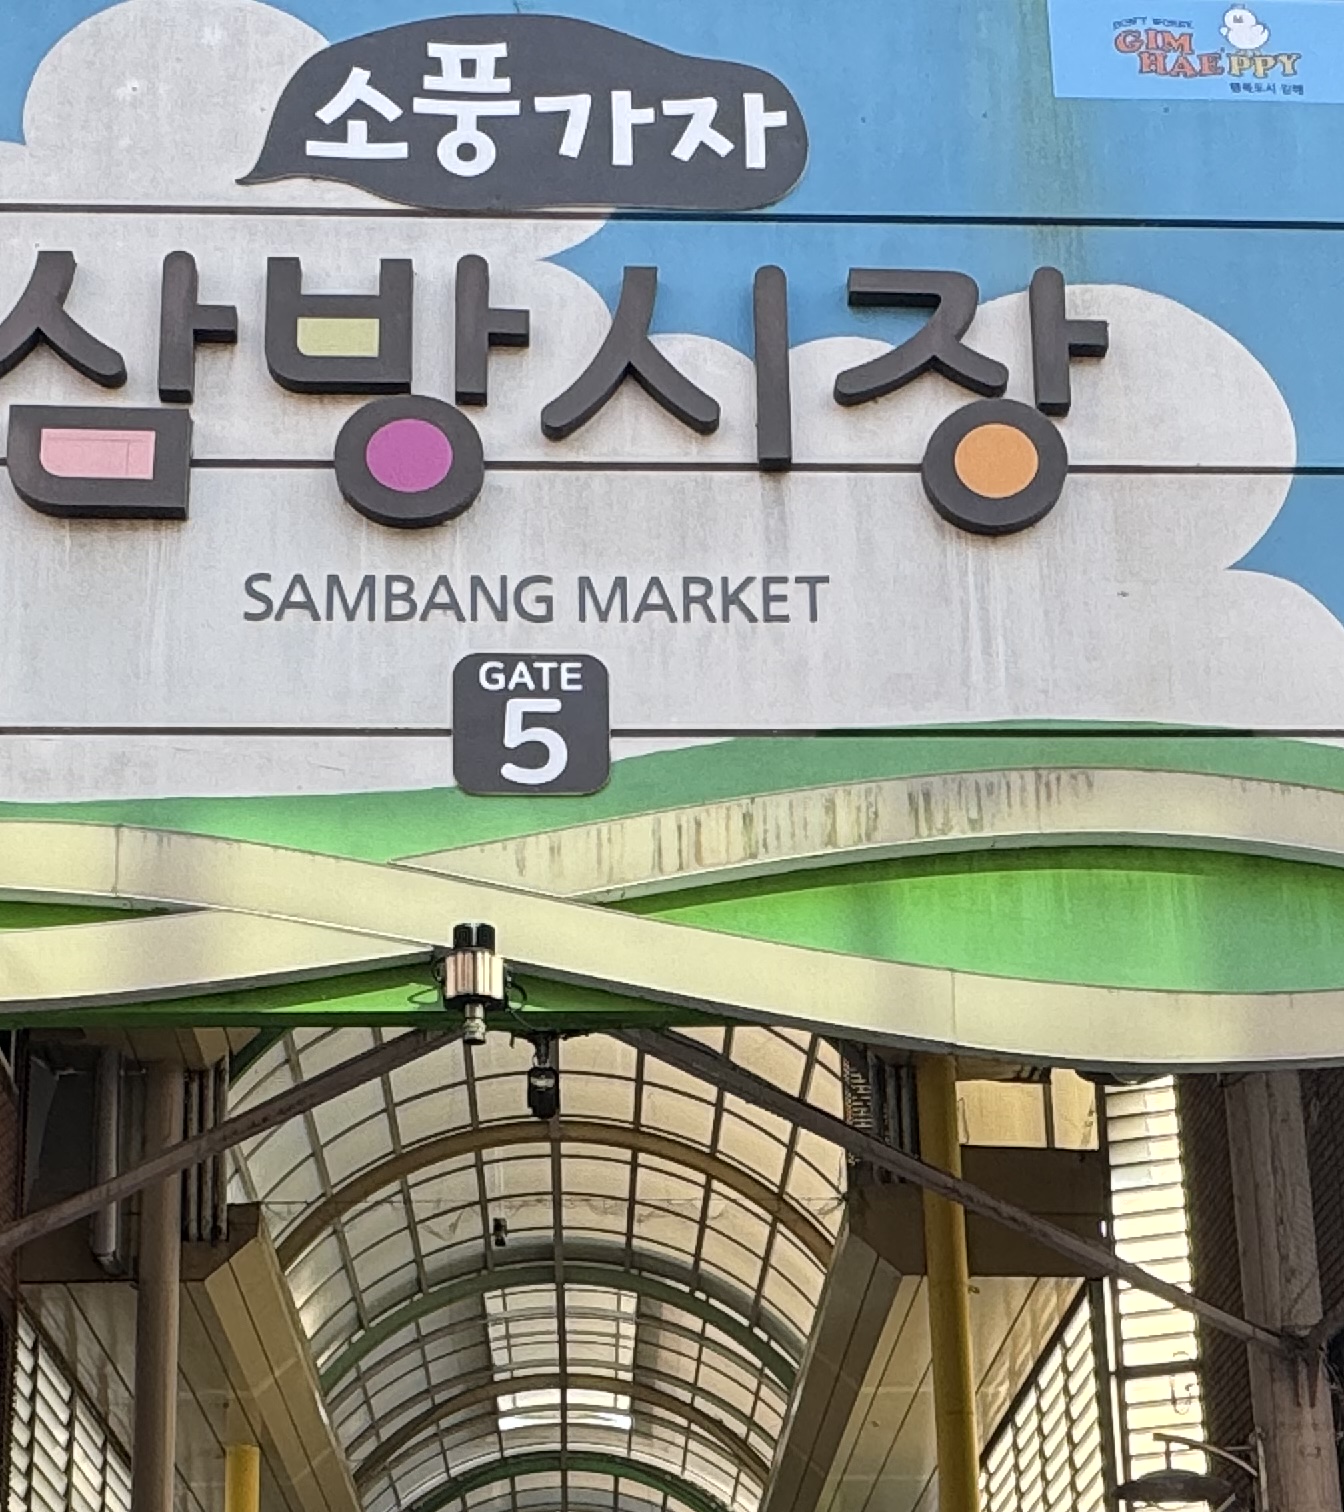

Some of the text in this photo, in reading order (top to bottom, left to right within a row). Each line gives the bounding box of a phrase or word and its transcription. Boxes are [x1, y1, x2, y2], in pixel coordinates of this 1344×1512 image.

[1113, 27, 1194, 56] GIM
[242, 572, 830, 626] SAMBANG MARKET
[477, 660, 584, 692] GATE
[498, 697, 569, 786] 5
